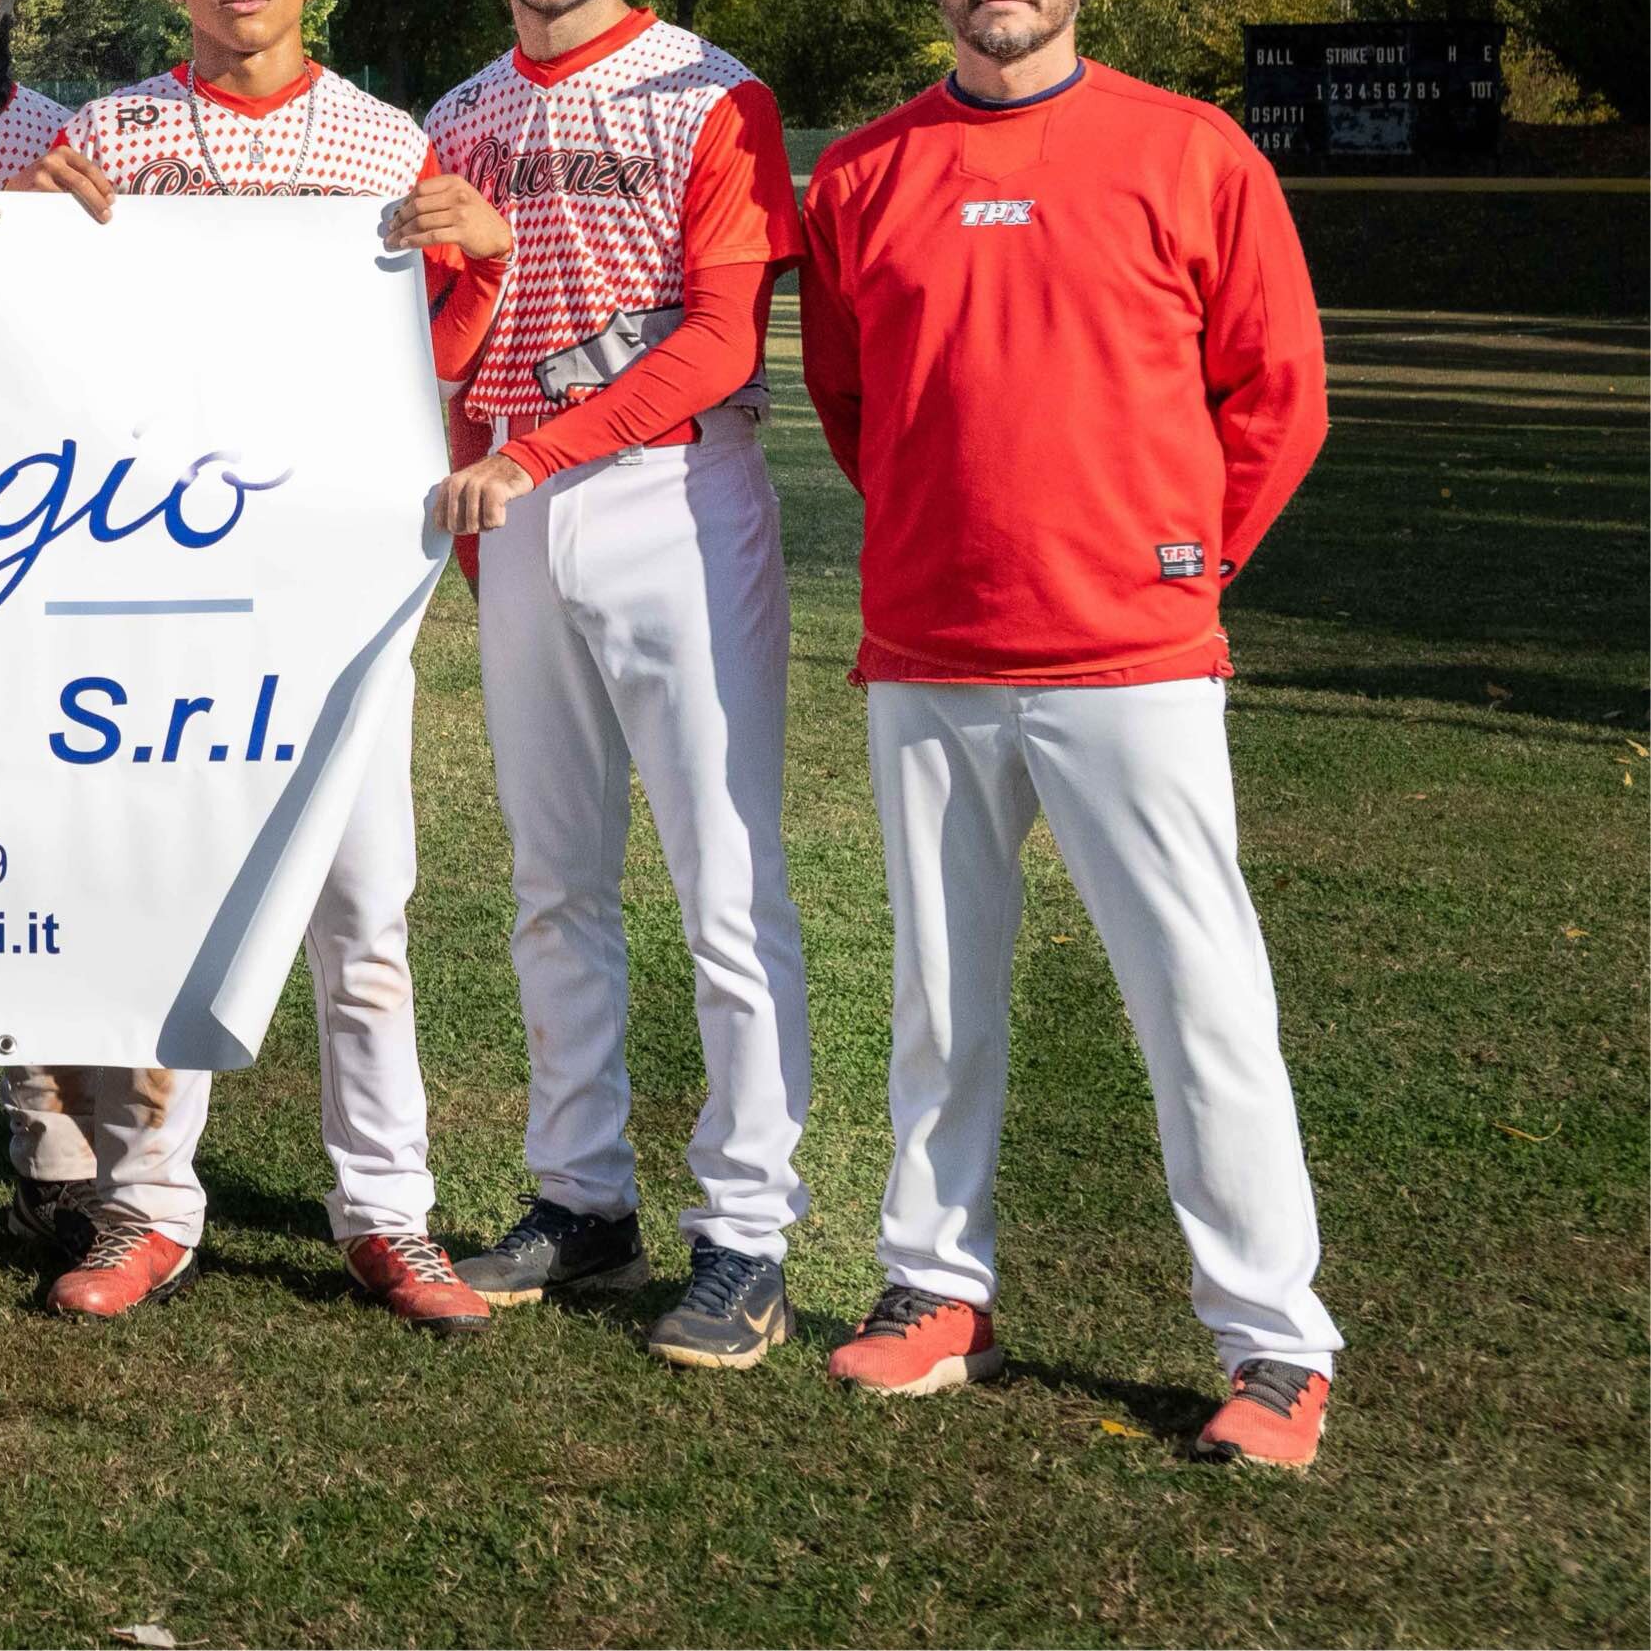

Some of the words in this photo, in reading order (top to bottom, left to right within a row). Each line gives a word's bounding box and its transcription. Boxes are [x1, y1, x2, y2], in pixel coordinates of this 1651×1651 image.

[1257, 48, 1294, 65] BALL
[1326, 47, 1368, 64] STRIKE
[1376, 47, 1405, 64] OUT
[1448, 46, 1457, 62] H
[1484, 45, 1493, 62] E
[1470, 82, 1493, 98] TOT
[1252, 106, 1305, 123] OSPITI
[1251, 133, 1291, 150] CASA
[961, 200, 1035, 225] TPX
[48, 673, 296, 764] S.r.l.
